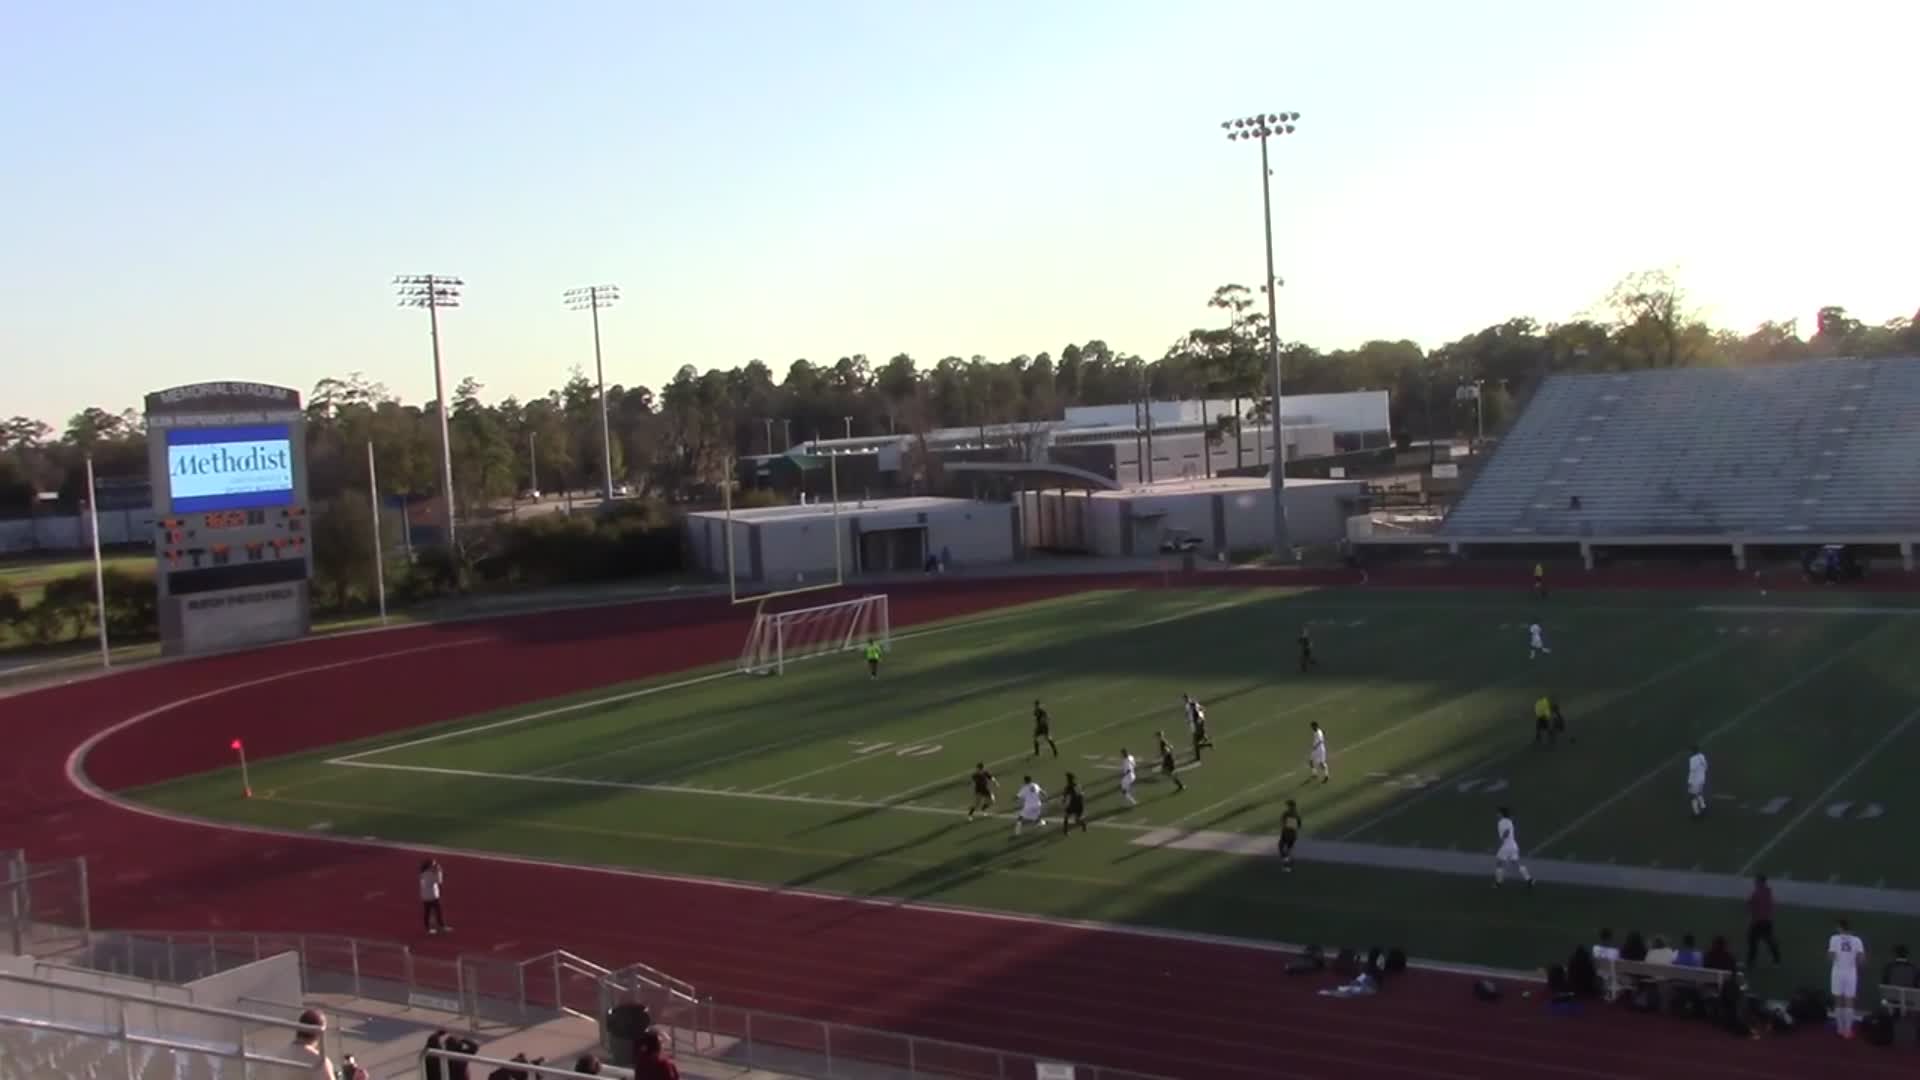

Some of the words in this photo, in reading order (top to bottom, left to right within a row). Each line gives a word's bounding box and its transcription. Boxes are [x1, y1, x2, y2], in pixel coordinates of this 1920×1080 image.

[160, 384, 230, 403] MEMORIAL
[232, 383, 288, 399] STADIUM
[169, 446, 288, 477] Methodist
